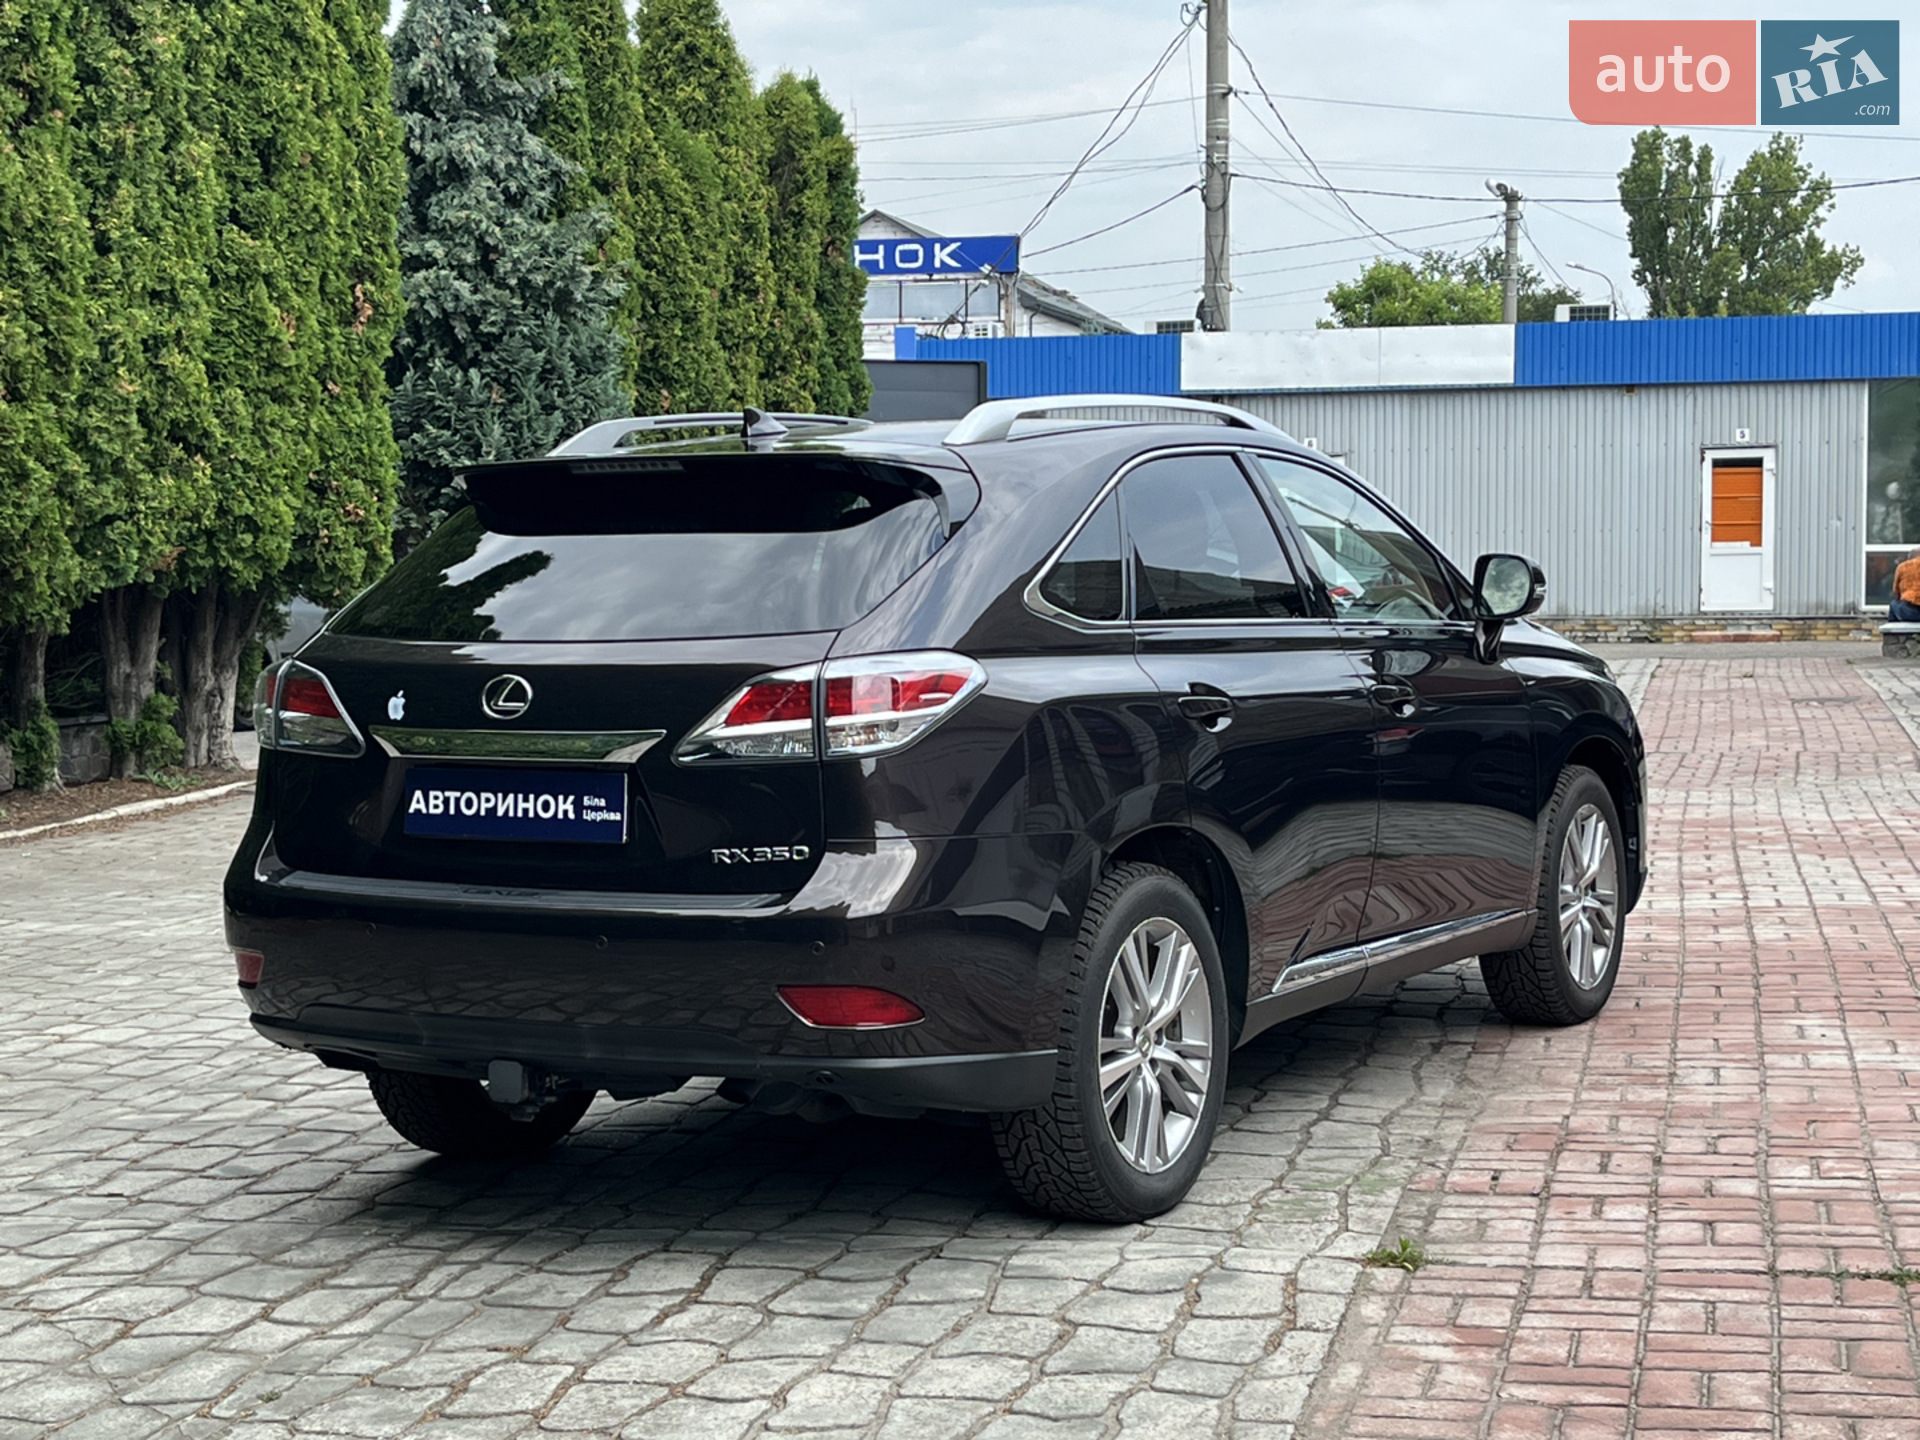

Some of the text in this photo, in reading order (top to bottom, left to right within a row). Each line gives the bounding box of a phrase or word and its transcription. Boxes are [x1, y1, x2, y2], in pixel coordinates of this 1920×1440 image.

[408, 789, 576, 820] АВТОРИНОК
[583, 795, 606, 807] Біла
[582, 809, 621, 822] Церква
